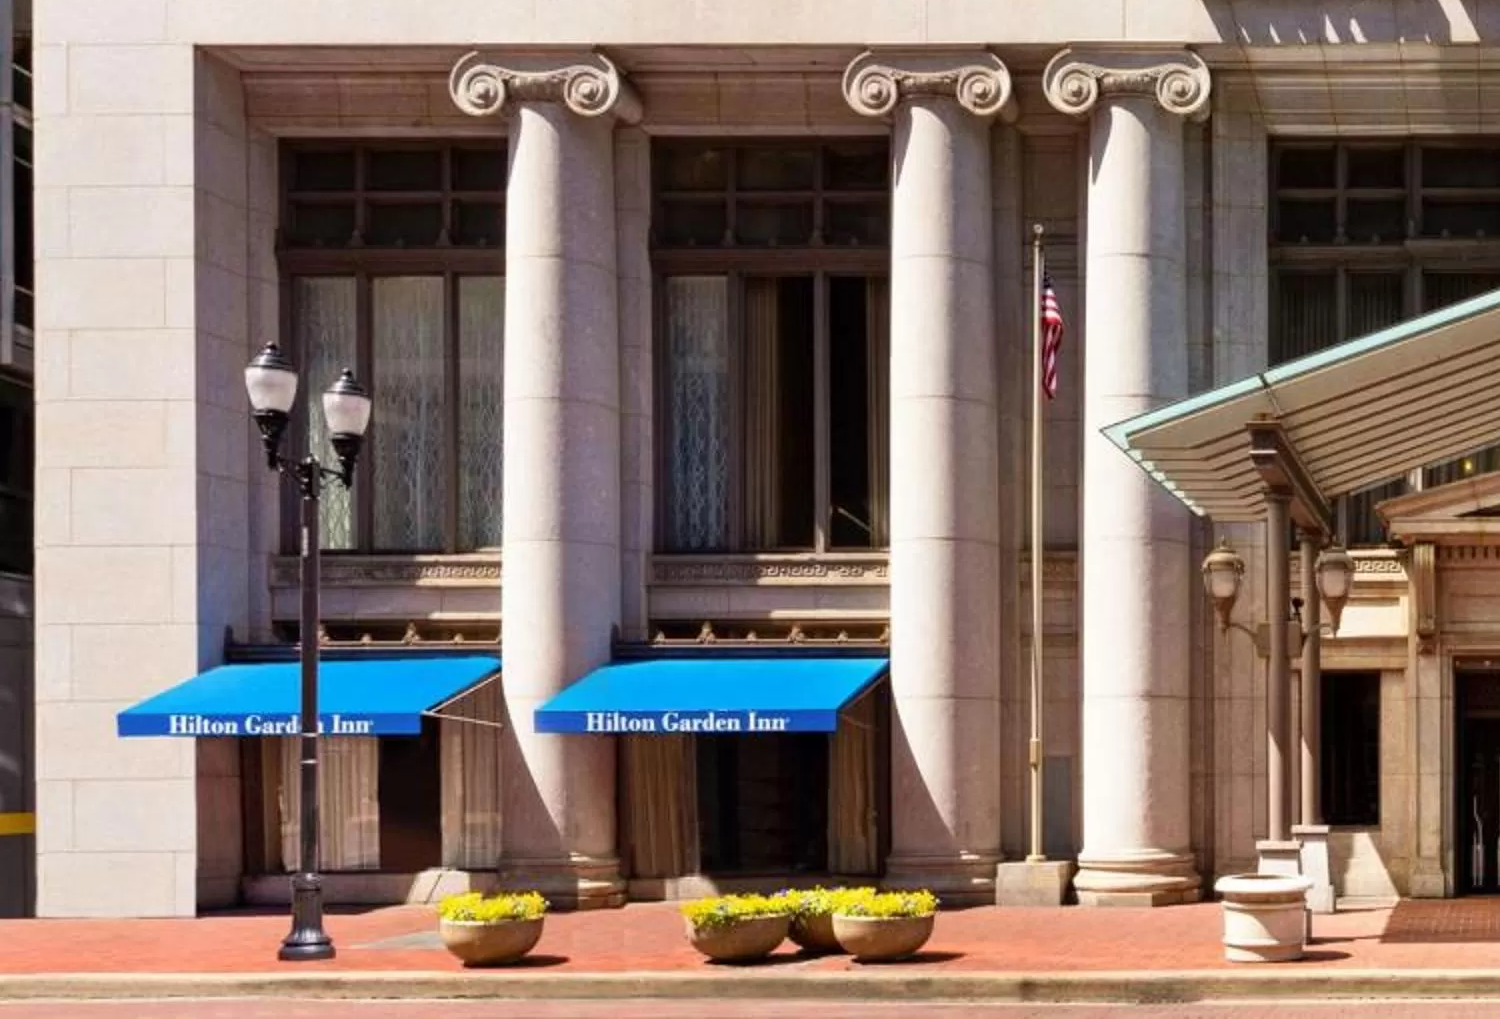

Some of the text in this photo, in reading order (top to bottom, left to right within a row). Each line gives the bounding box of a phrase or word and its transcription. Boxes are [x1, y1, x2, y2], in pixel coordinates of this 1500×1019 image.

[169, 714, 370, 735] Hilton Gard Inn
[586, 712, 786, 732] Hilton Garden Inn
